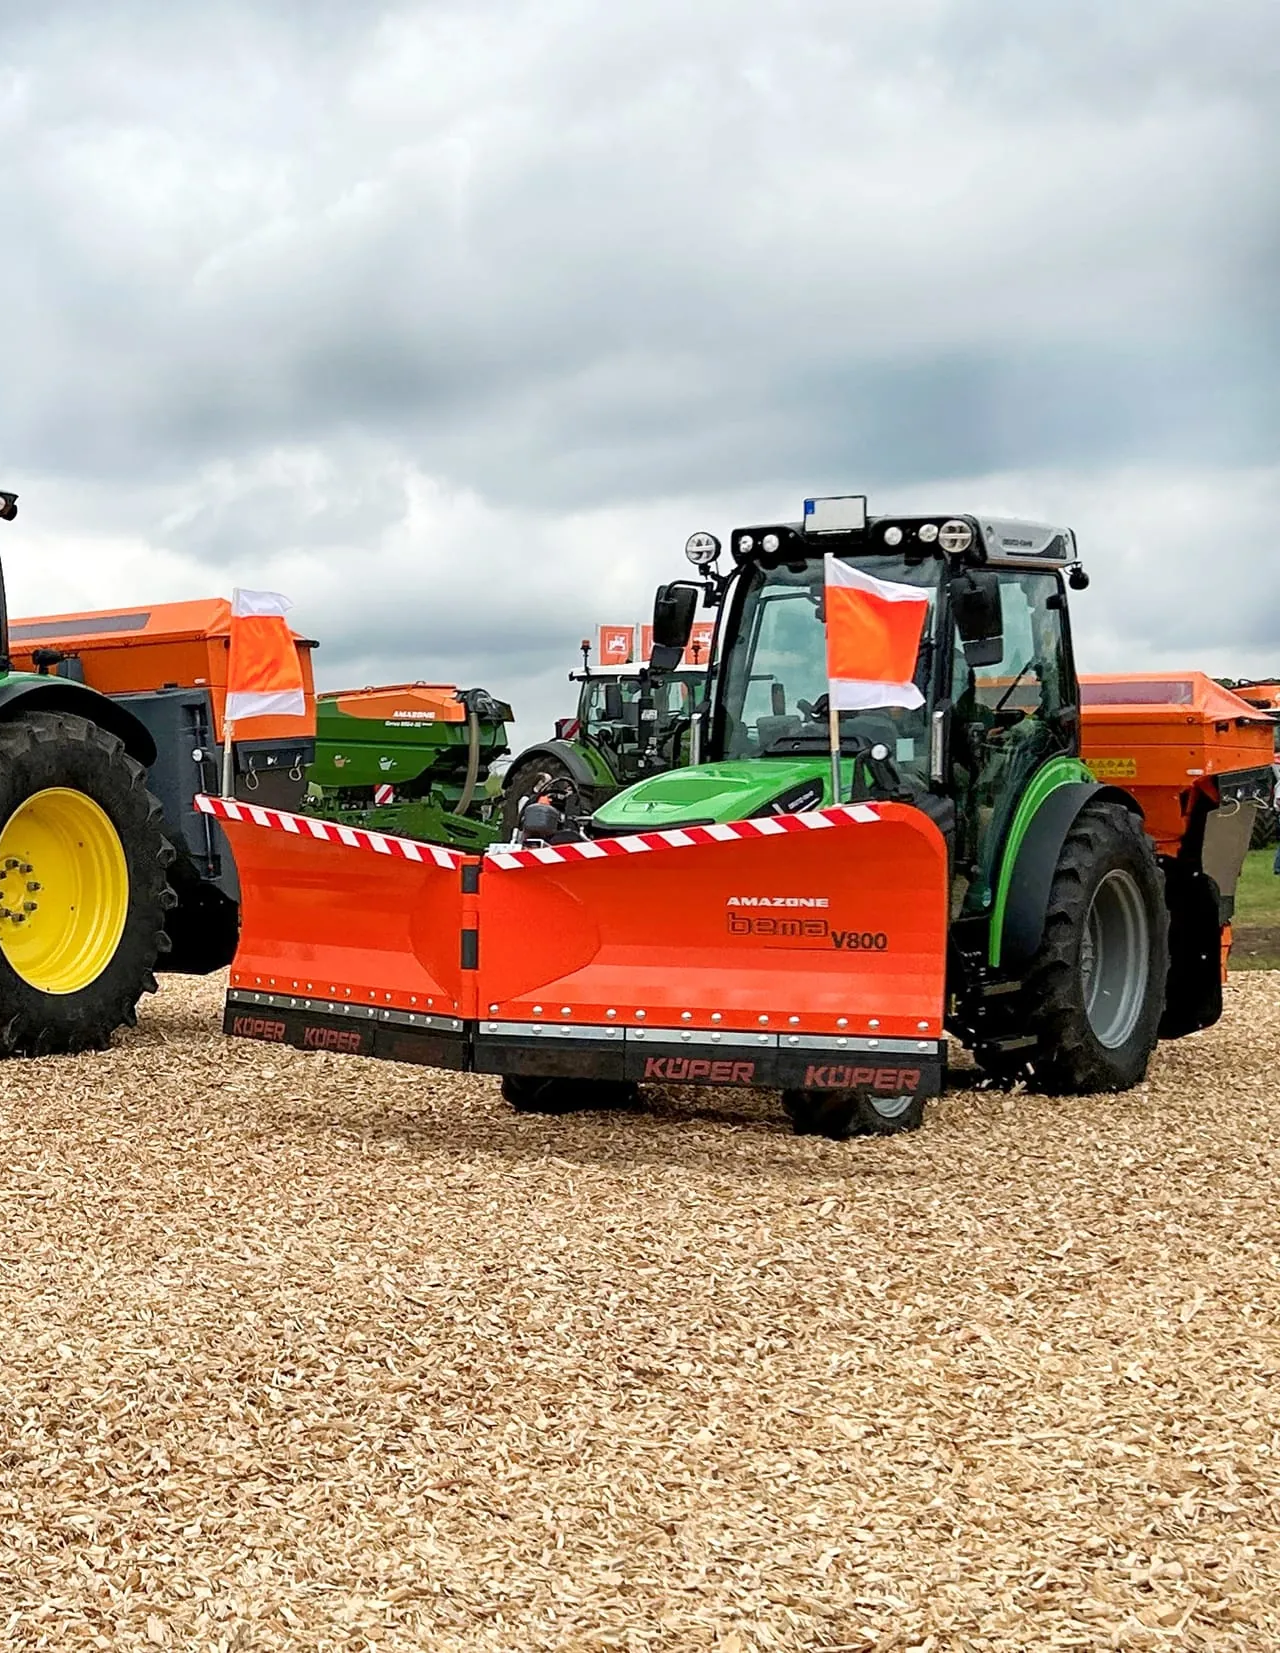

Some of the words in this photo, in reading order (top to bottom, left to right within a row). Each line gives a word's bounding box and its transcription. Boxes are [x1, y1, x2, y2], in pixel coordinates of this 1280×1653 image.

[727, 897, 830, 908] AMAZONE
[727, 912, 829, 937] bema
[831, 931, 888, 950] V800
[233, 1016, 286, 1041] KÜPER
[304, 1026, 361, 1052] KÜPER
[644, 1057, 755, 1083] KÜPER
[804, 1065, 920, 1091] KÜPER
